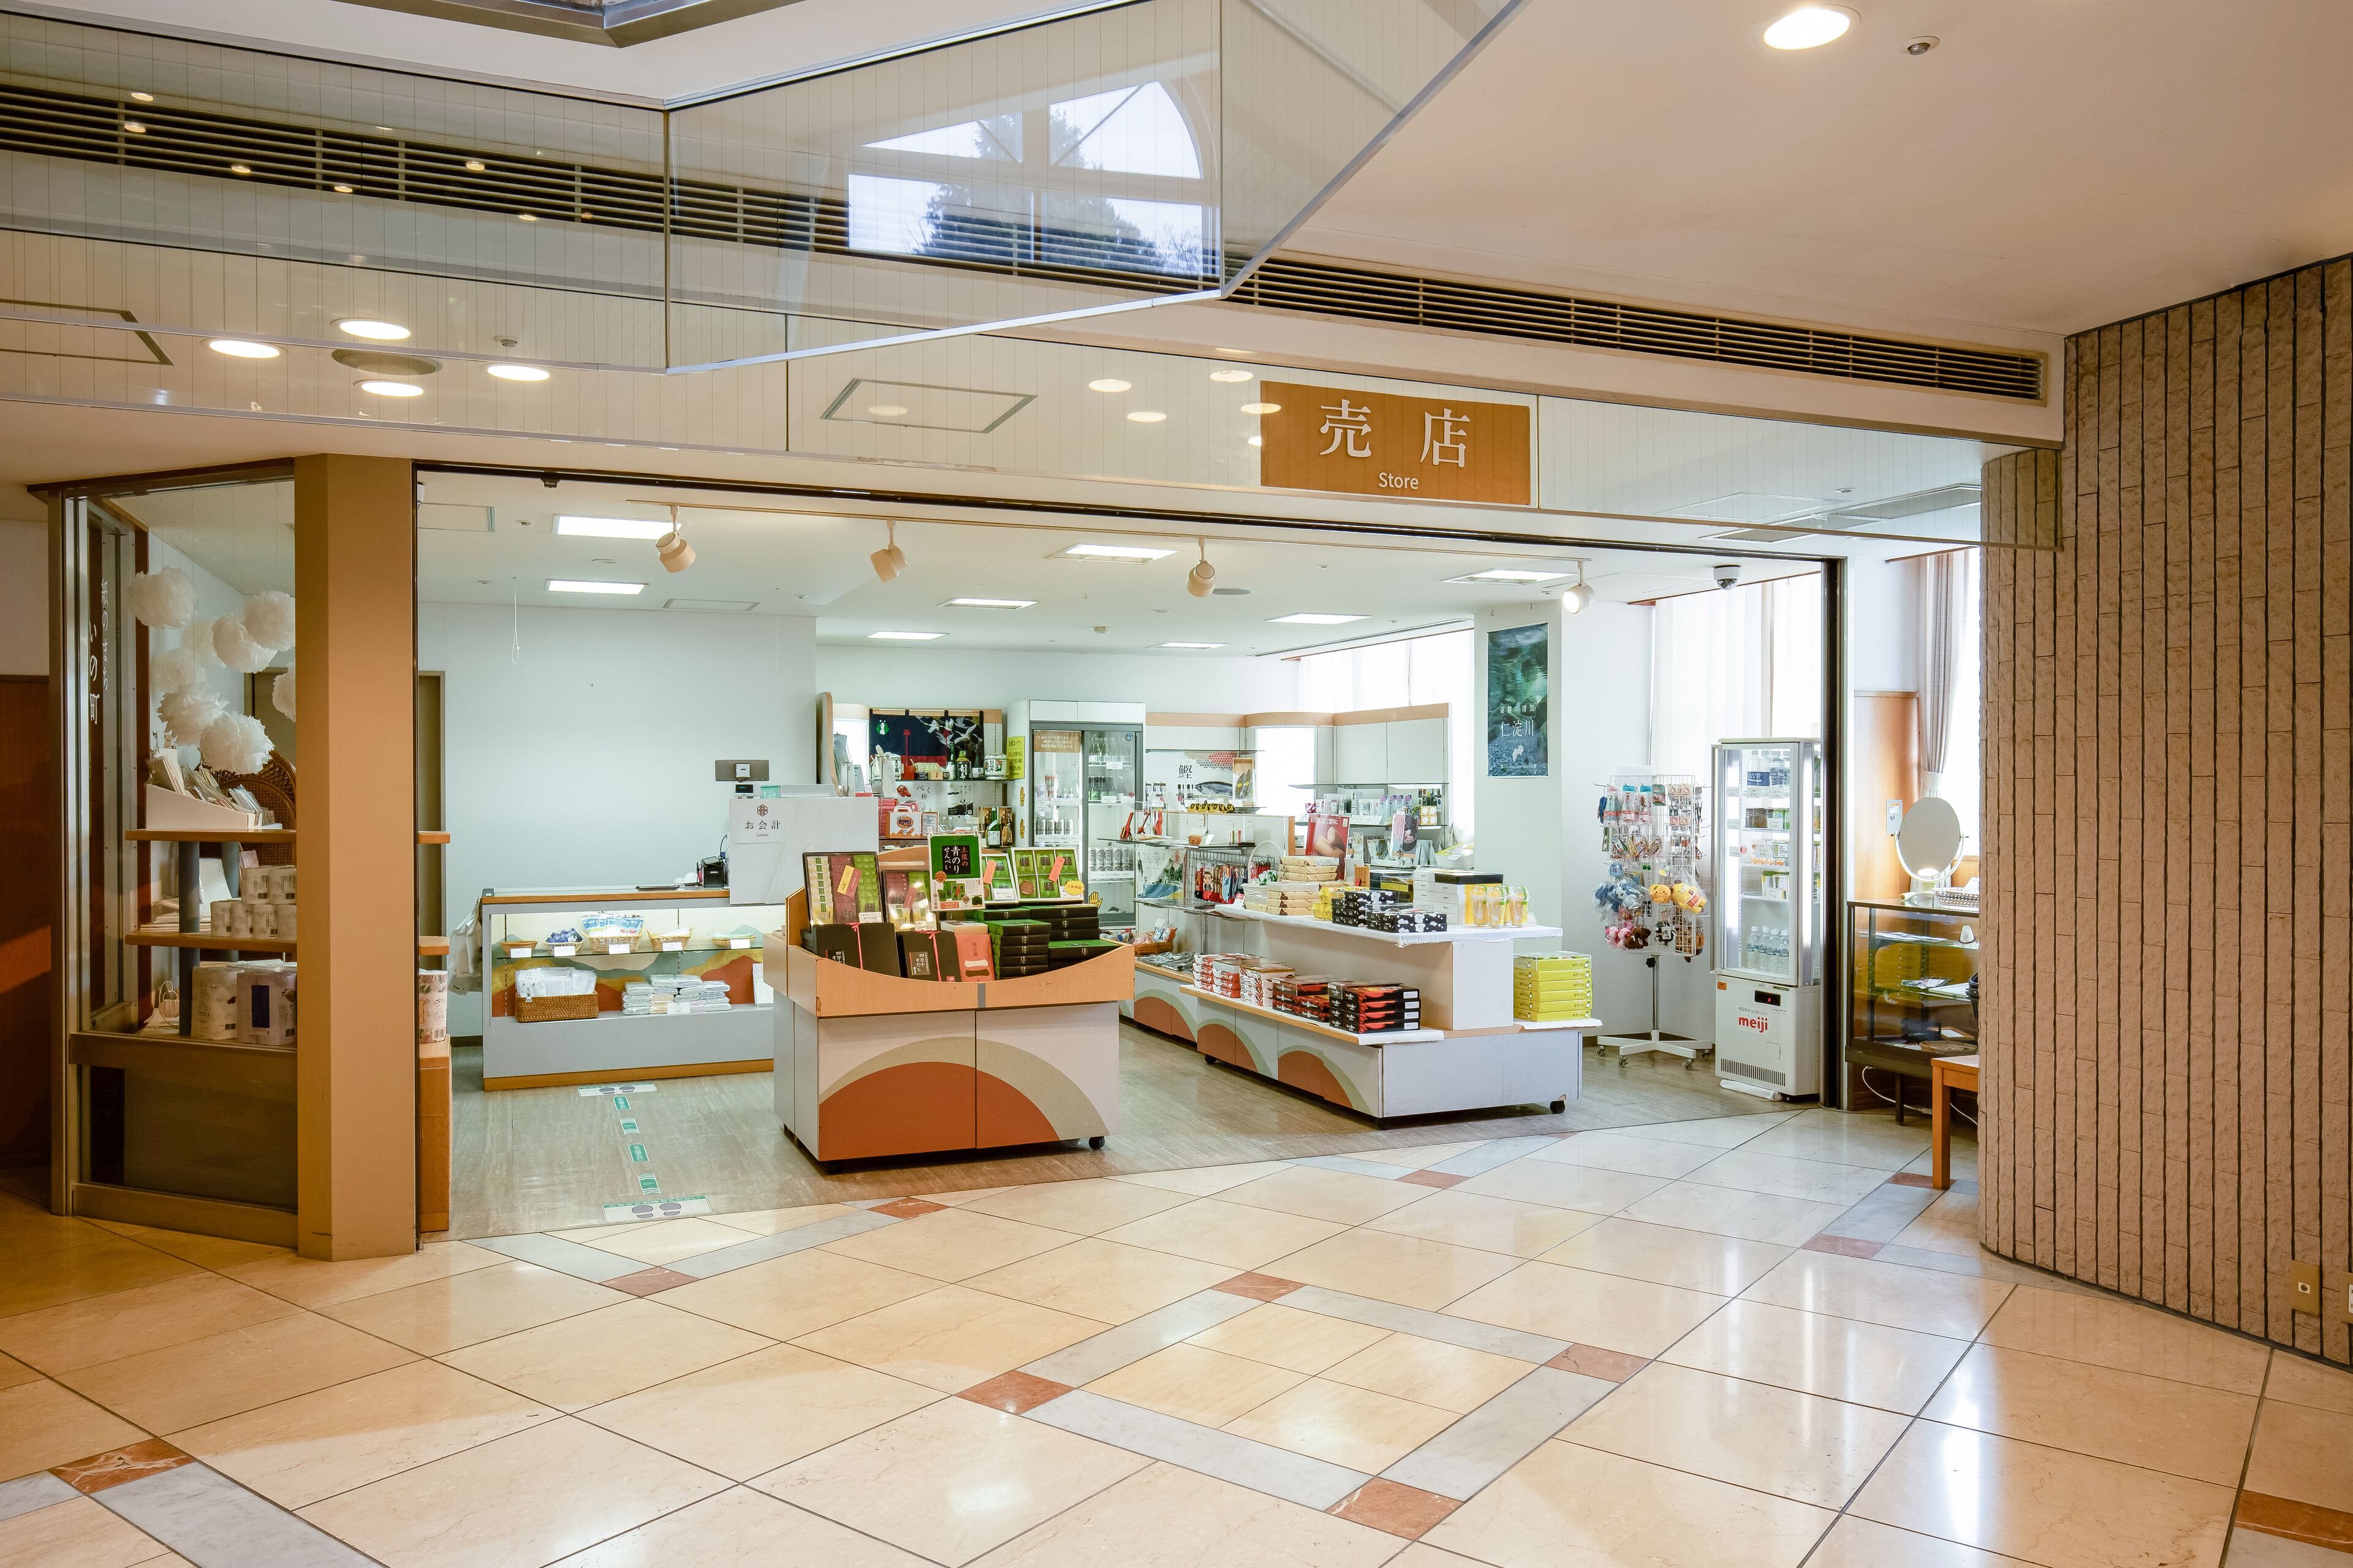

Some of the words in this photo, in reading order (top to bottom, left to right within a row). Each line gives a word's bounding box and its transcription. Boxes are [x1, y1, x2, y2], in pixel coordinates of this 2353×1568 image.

[1320, 398, 1471, 468] 売店
[1378, 471, 1419, 490] Store
[89, 620, 100, 725] いの町
[1500, 719, 1534, 738] 仁淀川
[745, 820, 781, 830] お会計
[950, 846, 961, 874] 青のり
[1738, 1016, 1768, 1033] meiji
